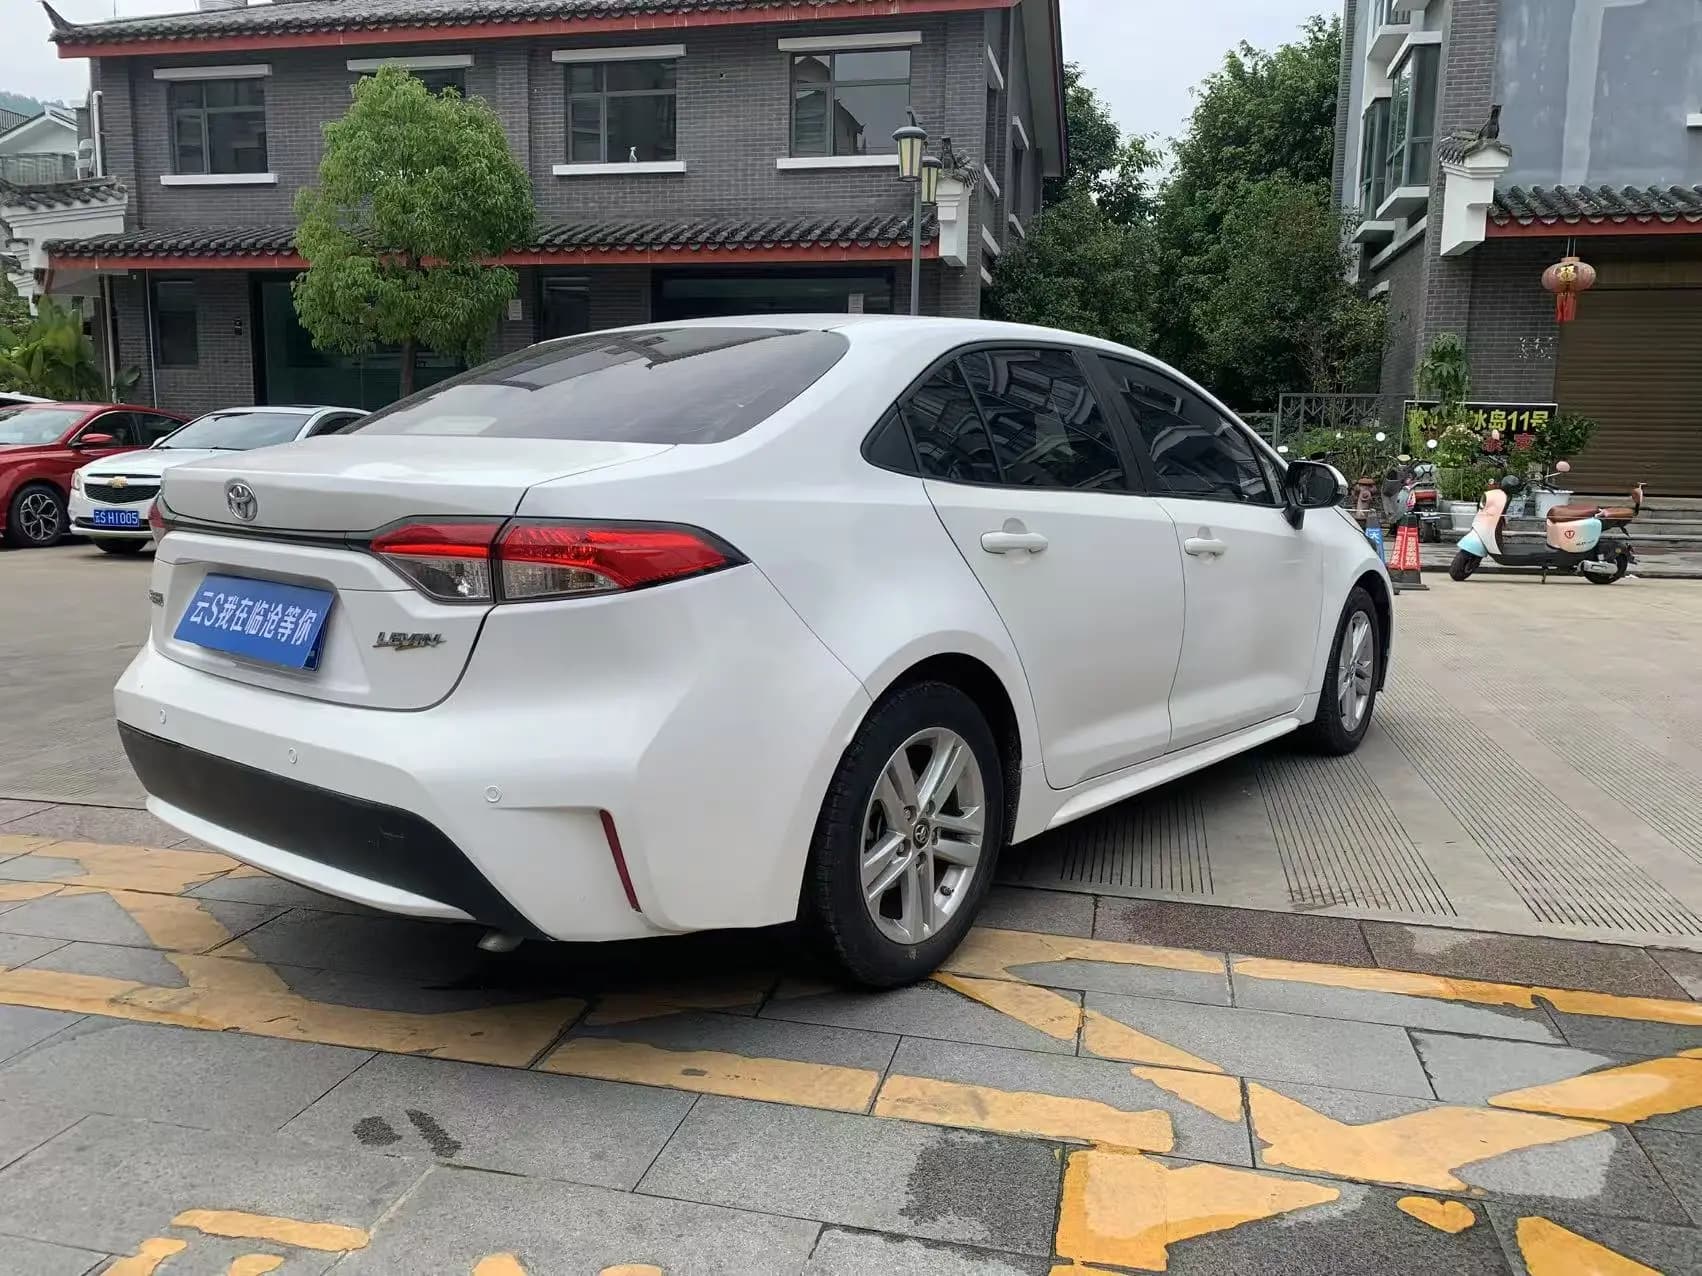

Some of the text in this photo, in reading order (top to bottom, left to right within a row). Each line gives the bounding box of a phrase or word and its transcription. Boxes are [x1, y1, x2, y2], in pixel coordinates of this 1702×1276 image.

[190, 591, 318, 645] 云S我在临沧等你
